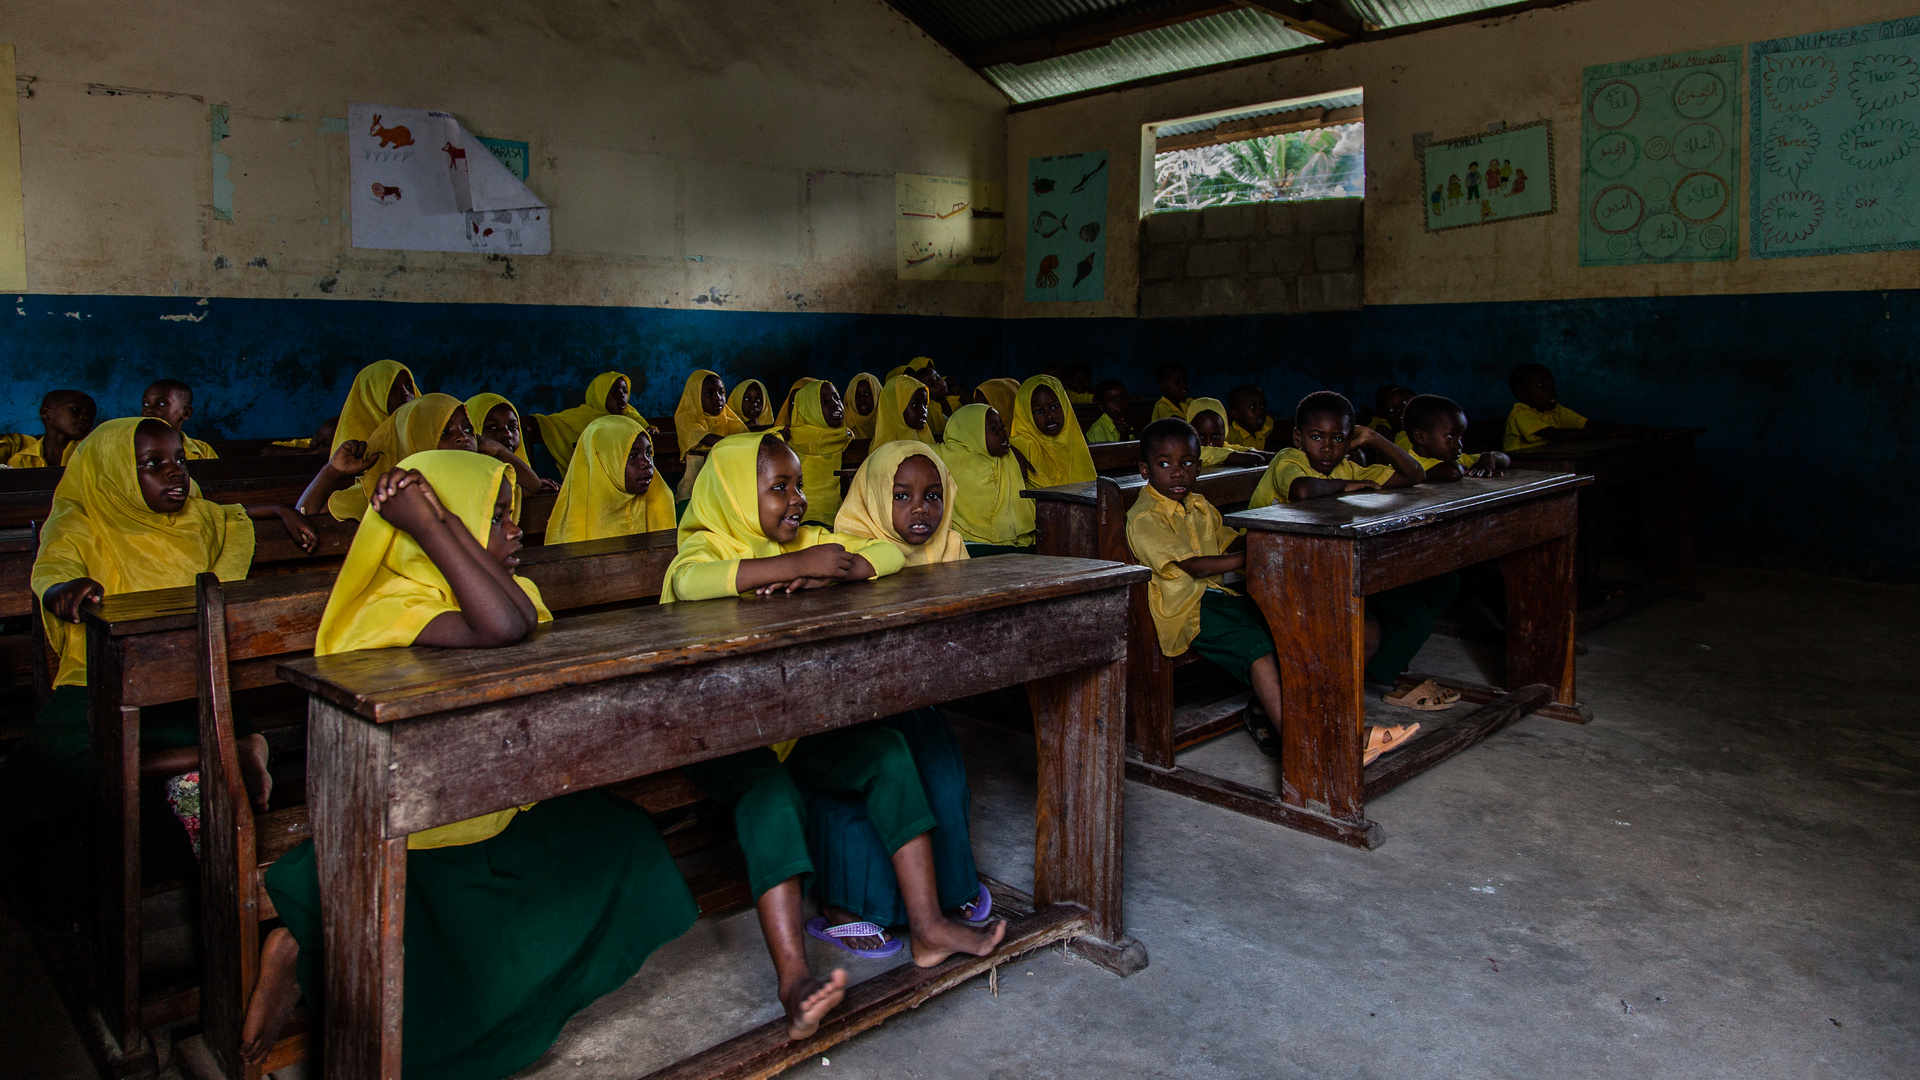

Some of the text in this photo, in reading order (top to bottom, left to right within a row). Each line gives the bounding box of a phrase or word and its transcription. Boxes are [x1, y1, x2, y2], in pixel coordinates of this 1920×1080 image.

[1795, 29, 1869, 51] NUMBERS
[1685, 54, 1727, 67] MUNGU
[1777, 73, 1817, 94] one
[1864, 69, 1897, 85] Two
[1775, 136, 1808, 148] Three
[1854, 135, 1882, 151] Four
[488, 146, 522, 158] DARASA
[1777, 208, 1800, 220] Five
